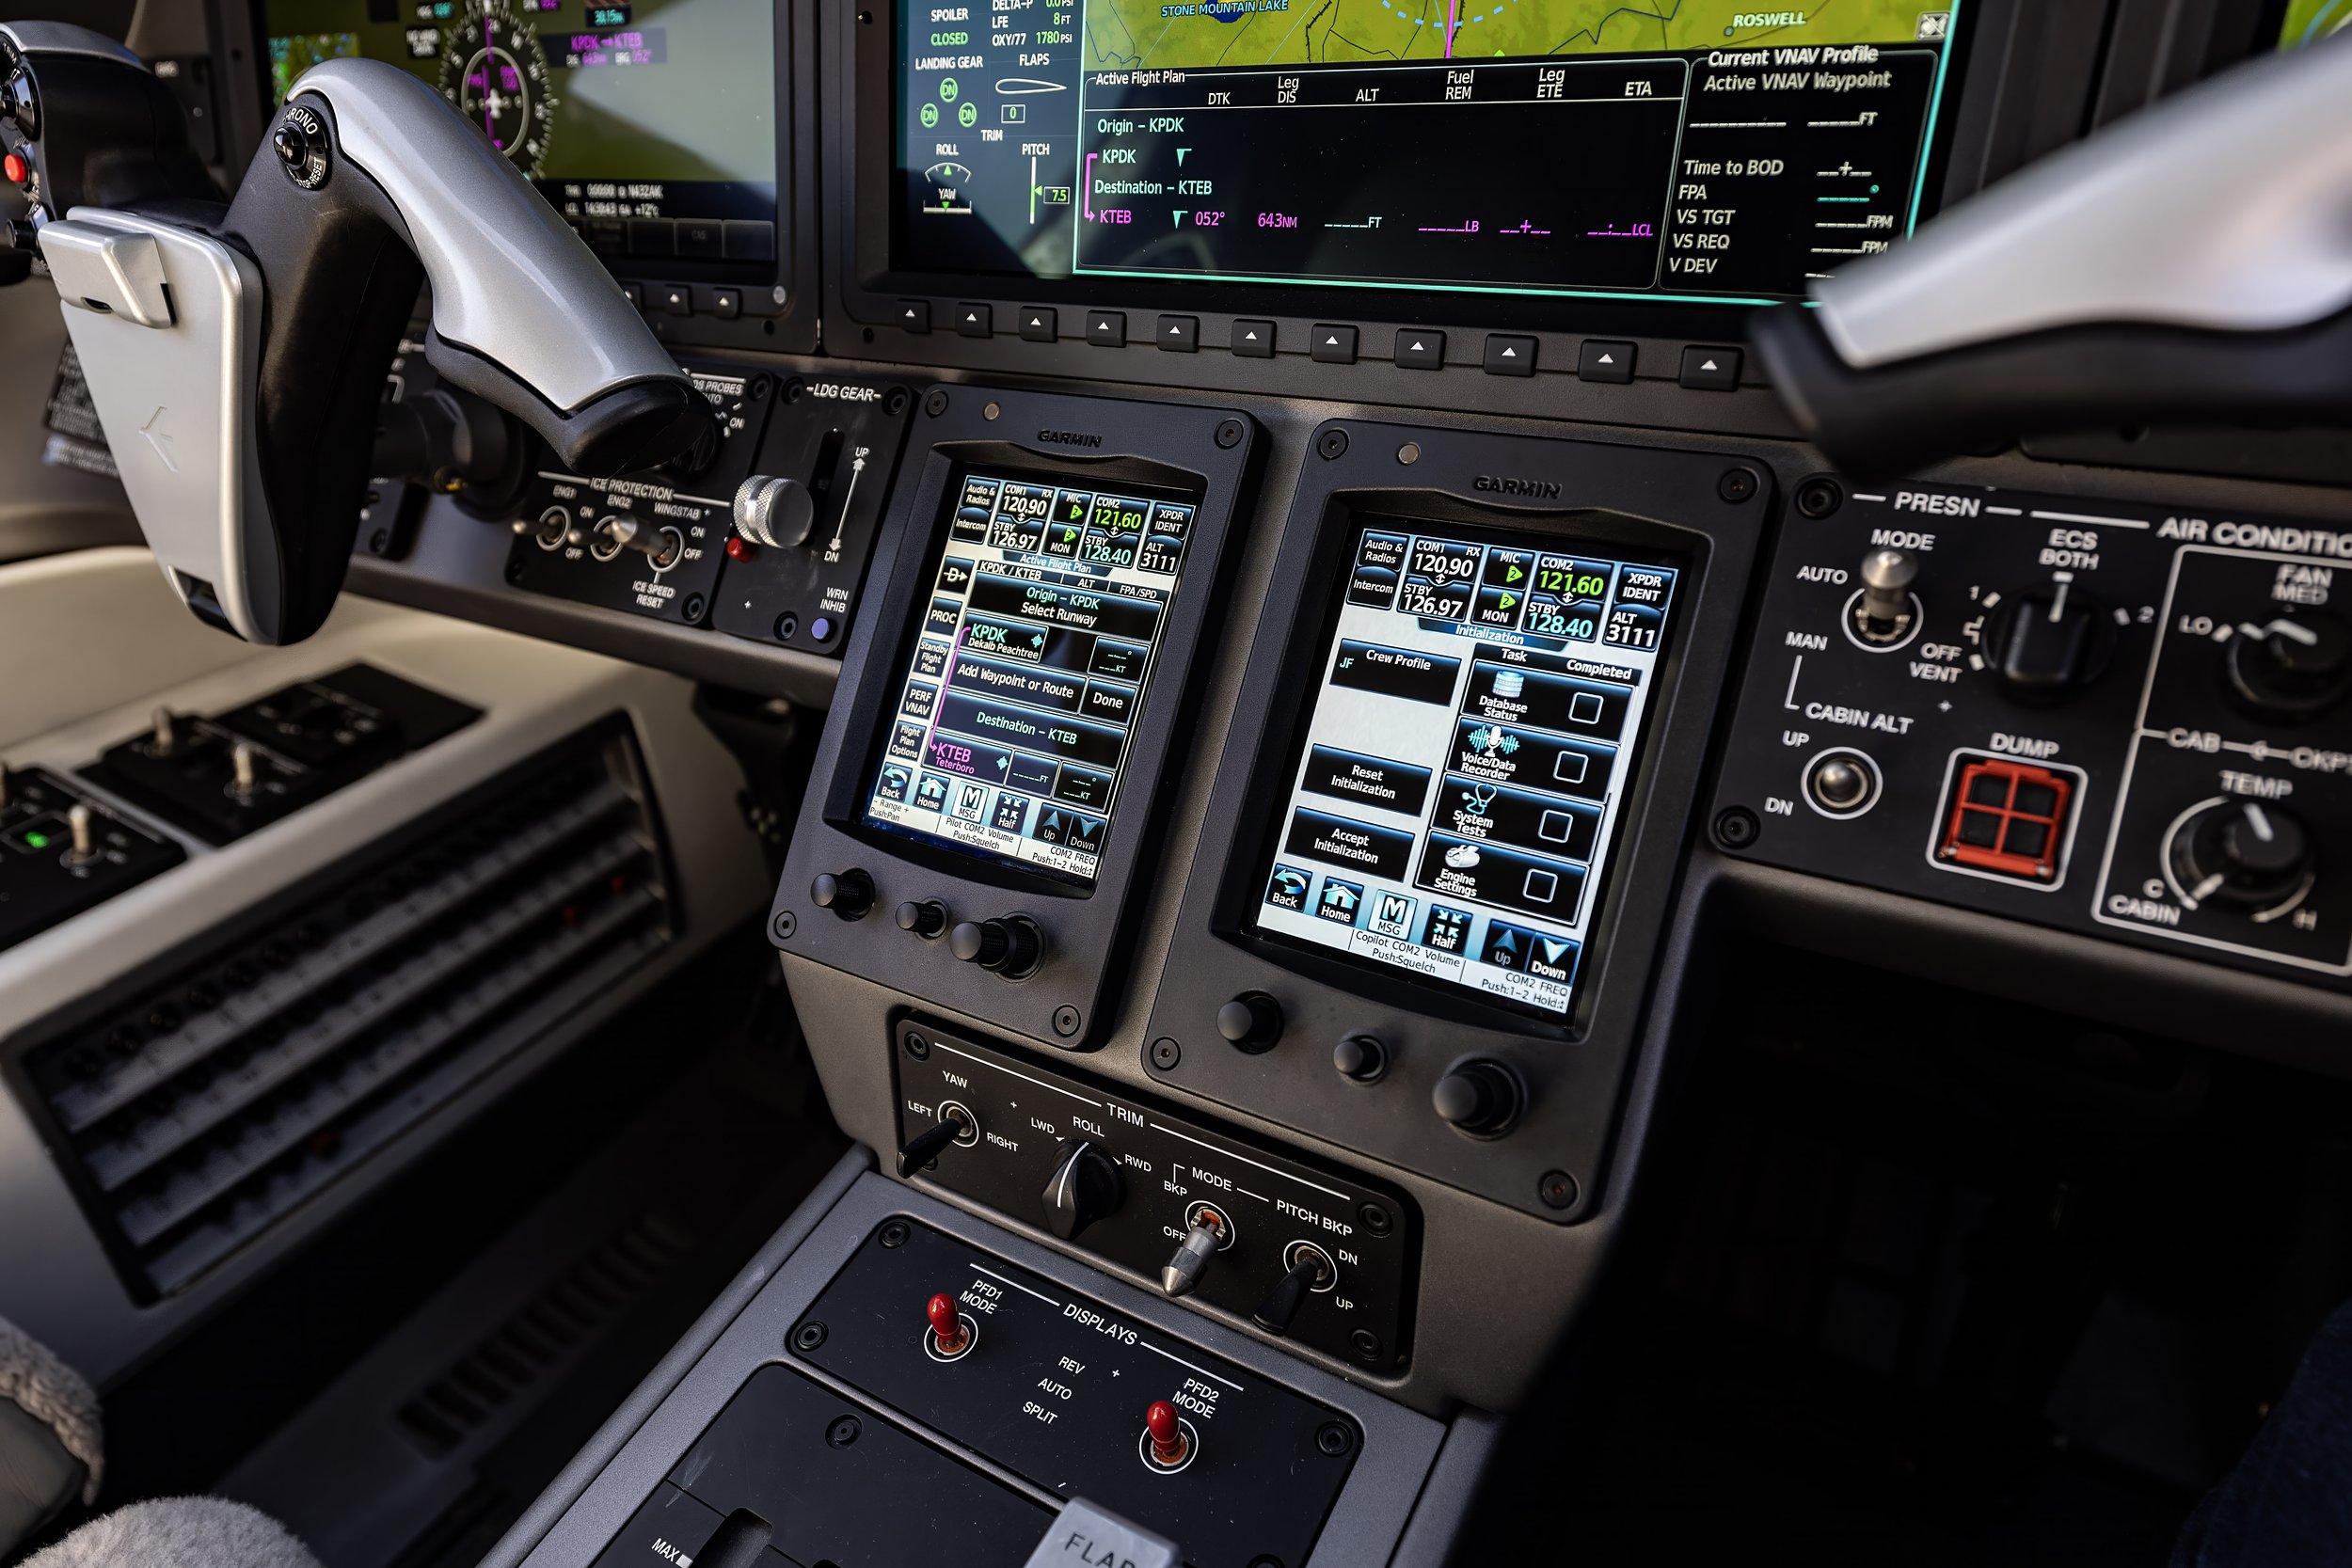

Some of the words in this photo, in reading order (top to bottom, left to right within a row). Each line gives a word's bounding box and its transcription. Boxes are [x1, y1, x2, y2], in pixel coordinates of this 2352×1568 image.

[931, 8, 968, 22] SPOILER
[1161, 5, 1197, 18] STONE
[1199, 2, 1258, 17] MOUNTAIN
[1260, 0, 1288, 12] LAKE
[1733, 12, 1805, 29] ROSWELL
[931, 32, 968, 46] CLOSED
[993, 33, 1026, 46] OXY/77
[1036, 30, 1059, 44] 1780
[1060, 33, 1072, 43] PSI
[915, 57, 956, 71] LANDING
[958, 55, 983, 69] GEAR
[1019, 54, 1049, 66] FLAPS
[1708, 50, 1770, 69] Current
[1772, 48, 1820, 65] VNAV
[1822, 45, 1879, 64] Profile
[1095, 71, 1128, 86] Active
[1131, 71, 1161, 85] Flight
[1164, 70, 1185, 84] Plan
[1447, 70, 1474, 85] Fuel
[1355, 89, 1379, 103] ALT
[1625, 82, 1652, 96] ETA
[1208, 92, 1231, 106] DTK
[980, 130, 1003, 141] TRIM
[1098, 118, 1134, 135] Origin
[1149, 118, 1184, 134] KPDK
[936, 144, 959, 155] ROLL
[1022, 143, 1050, 155] PITCH
[1684, 160, 1721, 177] Time
[1724, 161, 1743, 176] to
[1746, 160, 1785, 176] BOD
[939, 188, 956, 199] YAW
[1052, 190, 1067, 201] 7.5
[1095, 180, 1162, 196] Destination
[1178, 180, 1212, 195] KTEB
[1679, 185, 1707, 200] FPA
[1100, 209, 1132, 224] KTEB
[706, 381, 744, 396] PROBES
[814, 384, 838, 399] LDG
[841, 386, 874, 402] GEAR
[730, 418, 745, 429] ON
[1038, 429, 1102, 448] GARMIN
[855, 447, 868, 457] UP
[590, 478, 608, 488] ICE
[609, 480, 674, 501] PROTECTION
[1473, 475, 1563, 499] GARMIN
[607, 495, 632, 509] ENG2
[654, 502, 702, 519] WINGSTAB
[1002, 497, 1047, 515] 120.90
[1895, 491, 1980, 517] PRESN
[580, 506, 595, 518] ON
[1095, 509, 1141, 529] 121.60
[691, 526, 706, 537] ON
[2156, 517, 2209, 541] AIR
[1870, 529, 1936, 551] MODE
[2049, 529, 2098, 550] ECS
[825, 550, 838, 562] DN
[1416, 541, 1445, 553] COM1
[1466, 546, 1481, 557] RX
[1501, 551, 1521, 563] MIC
[1414, 554, 1473, 578] 120.90
[1541, 557, 1574, 570] COM2
[2040, 548, 2100, 570] BOTH
[1540, 570, 1604, 596] 121.60
[1629, 573, 1661, 587] XPDR
[1797, 565, 1848, 585] AUTO
[2277, 564, 2332, 588] FAN
[632, 580, 647, 592] ICE
[647, 583, 675, 598] SPEED
[826, 587, 848, 600] WRN
[1354, 579, 1393, 594] Intercom
[1404, 583, 1433, 596] STBY
[1622, 586, 1661, 602] IDENT
[636, 595, 665, 609] RESET
[820, 599, 845, 612] INHIB
[1403, 595, 1463, 619] 126.97
[1529, 602, 1559, 615] STBY
[930, 610, 957, 624] PROC
[1021, 602, 1055, 619] Select
[1057, 608, 1097, 627] Runway
[1612, 611, 1637, 625] ALT
[1528, 613, 1593, 638] 128.40
[2178, 615, 2213, 635] LO
[1455, 625, 1524, 645] Initialization
[1606, 624, 1655, 646] 3111
[1786, 632, 1827, 651] MAN
[1365, 650, 1393, 664] Crew
[1395, 654, 1432, 670] Profile
[1921, 643, 1963, 660] OFF
[1340, 657, 1354, 670] JF
[1566, 659, 1632, 680] Completed
[1910, 662, 1963, 683] VENT
[957, 663, 977, 678] Add
[980, 668, 1026, 689] Waypoint
[1028, 679, 1041, 690] or
[1042, 681, 1074, 698] Route
[1092, 692, 1123, 708] Done
[1479, 696, 1528, 713] Database
[1805, 702, 1870, 728] CABIN
[1870, 713, 1914, 735] ALT
[1783, 730, 1809, 747] UP
[1990, 732, 2059, 759] DUMP
[935, 758, 975, 775] Teterboro
[1462, 752, 1517, 771] Voice/Data
[1352, 765, 1384, 781] Reset
[1461, 761, 1510, 781] Recorder
[1331, 776, 1396, 800] Initialization
[2218, 769, 2293, 800] TEMP
[1764, 798, 1793, 816] DN
[1331, 829, 1369, 847] Accept
[1314, 839, 1378, 863] Initialization
[1440, 869, 1475, 887] Engine
[1434, 878, 1477, 897] Settings
[1272, 893, 1297, 908] Back
[1321, 906, 1351, 923] Home
[2108, 895, 2181, 926] CABIN
[1378, 921, 1401, 936] MSG
[1356, 931, 1389, 949] Copilot
[1391, 940, 1420, 955] COM2
[1424, 948, 1460, 967] Volume
[1432, 934, 1456, 950] Half
[1532, 961, 1566, 980] Down
[943, 1070, 968, 1088] YAW
[908, 1100, 932, 1118] LEFT
[1106, 1103, 1145, 1128] TRIM
[1031, 1117, 1055, 1135] LWD
[1073, 1116, 1105, 1138] ROLL
[986, 1132, 1019, 1153] RIGHT
[1124, 1154, 1152, 1173] RWD
[1163, 1180, 1188, 1197] BKP
[1192, 1167, 1232, 1192] MODE
[1277, 1199, 1319, 1227] PITCH
[1323, 1217, 1353, 1237] BKP
[1163, 1226, 1186, 1243] OFF
[1338, 1249, 1359, 1265] DN
[971, 1279, 1003, 1303] PFD1
[960, 1289, 998, 1316] MODE
[1336, 1298, 1353, 1311] UP
[1062, 1303, 1138, 1346] DISPLAYS
[1057, 1355, 1086, 1374] REV
[1037, 1377, 1073, 1400] AUTO
[1184, 1377, 1219, 1402] PFD2
[1172, 1388, 1217, 1419] MODE
[1022, 1401, 1057, 1425] SPLIT
[651, 1538, 680, 1561] MAX
